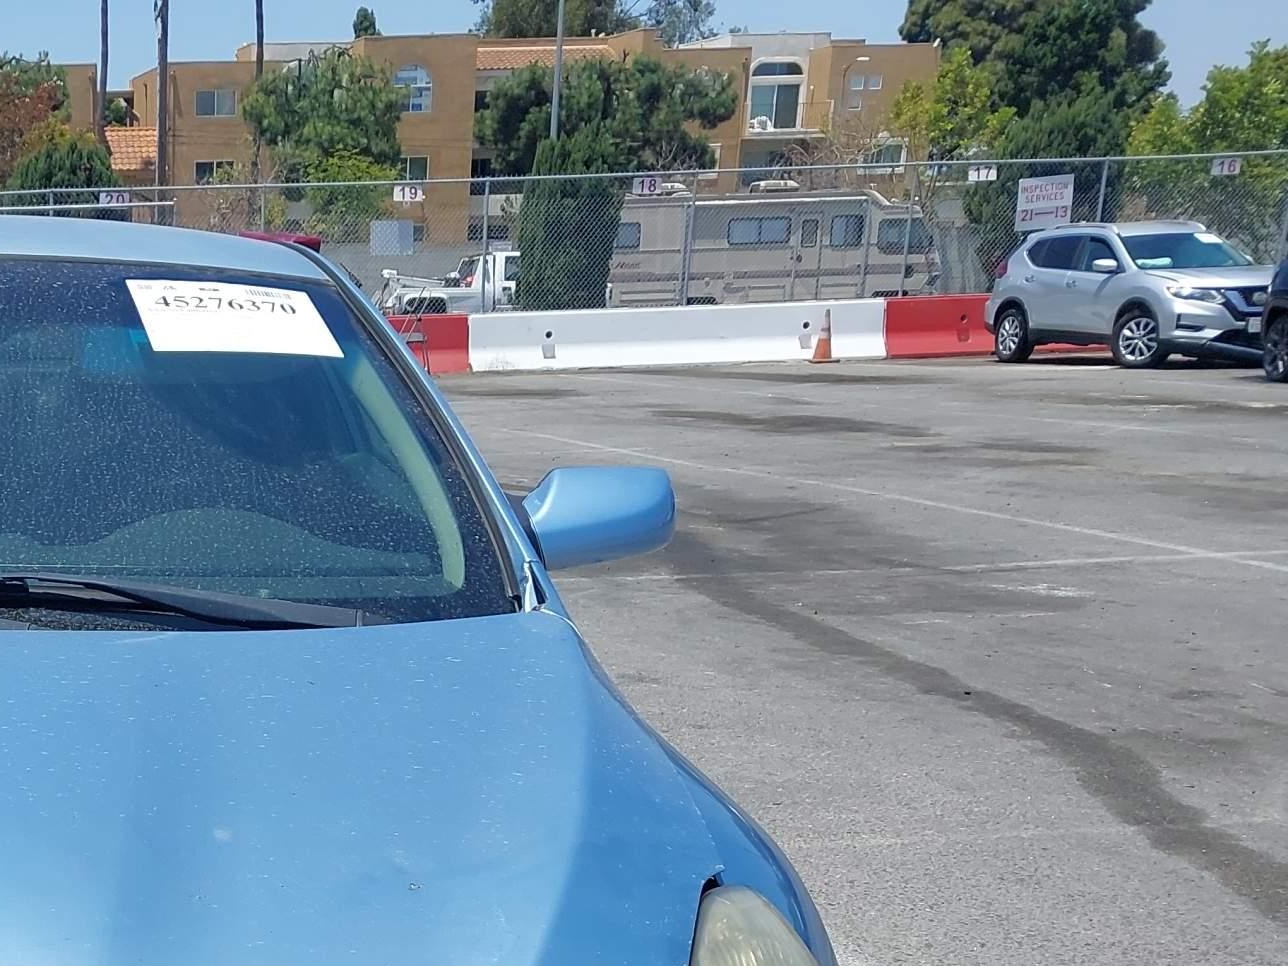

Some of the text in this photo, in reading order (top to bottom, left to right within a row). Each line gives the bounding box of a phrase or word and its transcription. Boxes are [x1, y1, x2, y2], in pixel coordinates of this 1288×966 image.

[974, 165, 992, 180] 17
[1218, 159, 1237, 173] 16
[638, 178, 657, 193] 18
[1021, 182, 1070, 195] INSPECTION
[105, 193, 125, 204] 20
[399, 185, 418, 201] 19
[1025, 191, 1065, 204] SERVICES
[154, 295, 297, 315] 45276370
